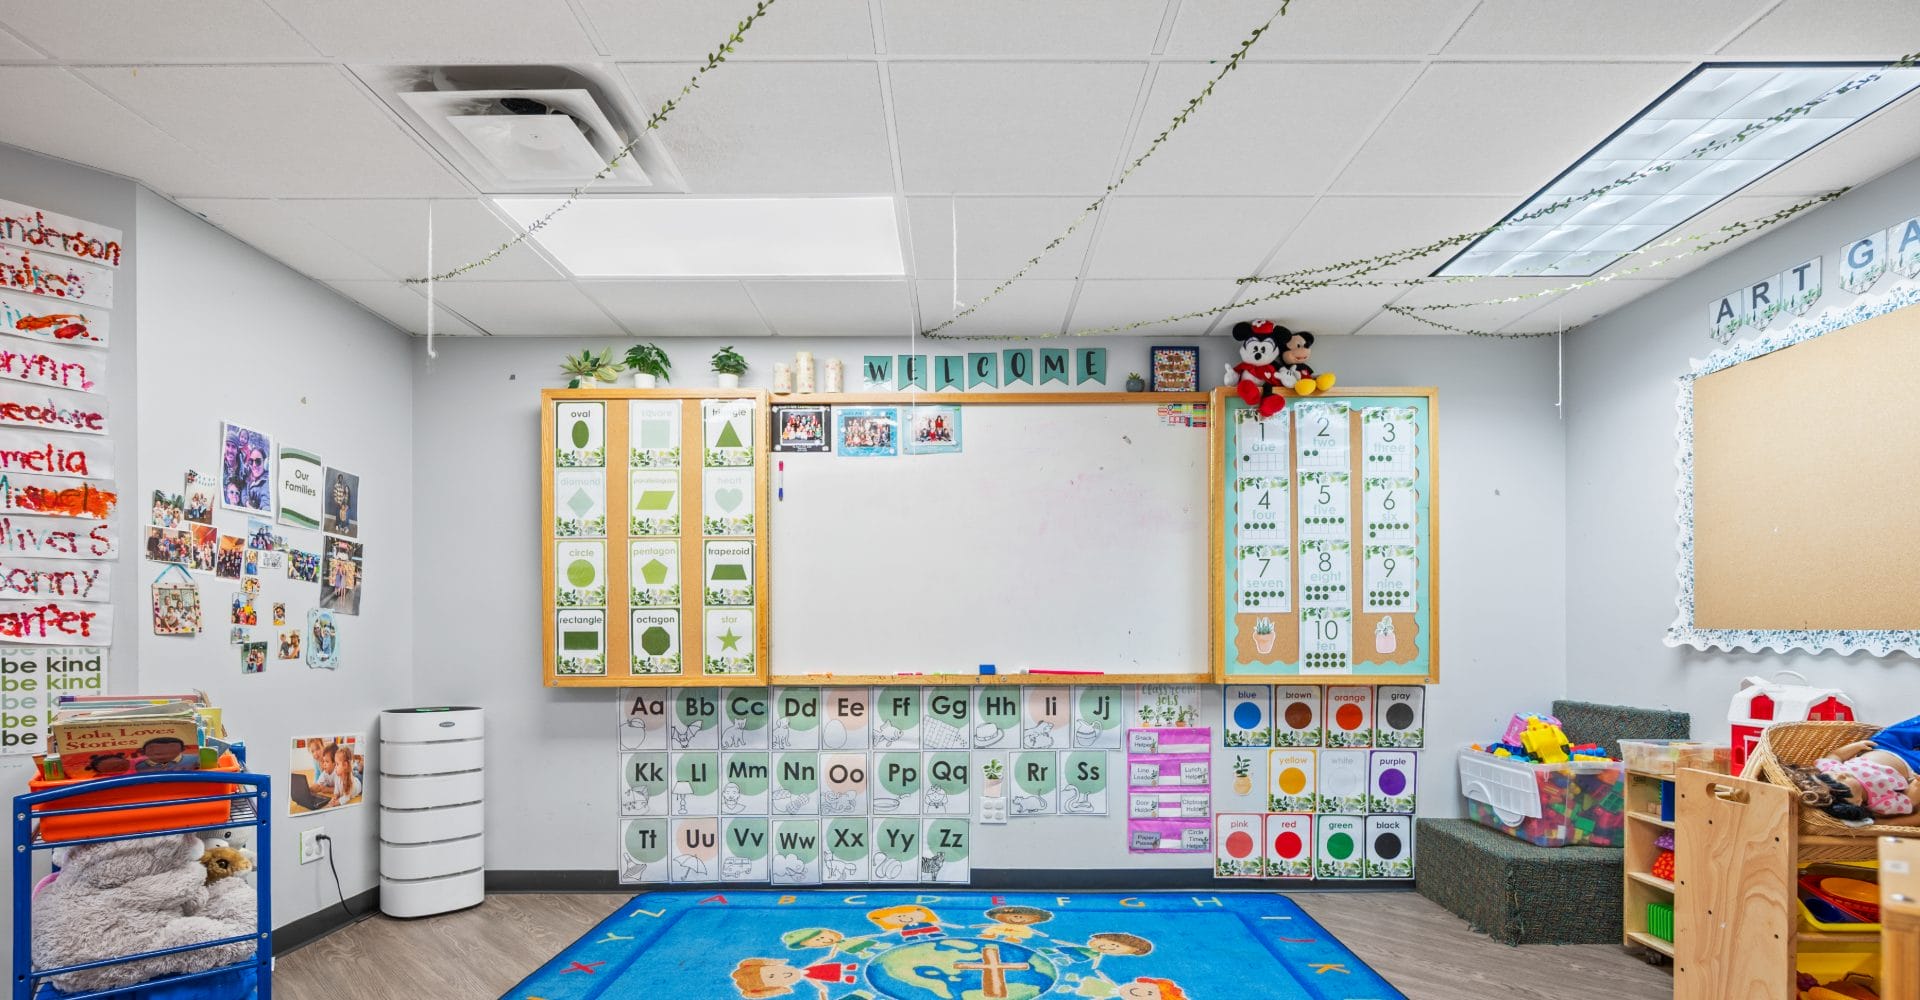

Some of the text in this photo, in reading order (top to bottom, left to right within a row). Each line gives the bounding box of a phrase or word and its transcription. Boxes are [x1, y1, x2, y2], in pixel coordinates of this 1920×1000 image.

[0, 211, 121, 267] nderson
[1716, 262, 1811, 324] ART
[868, 351, 1096, 384] WELCOME
[0, 398, 104, 431] eodore
[570, 409, 591, 419] oval
[711, 408, 747, 418] trigle
[1258, 422, 1265, 441] 1
[1316, 417, 1331, 437] 2
[1382, 422, 1396, 442] 3
[1312, 437, 1336, 447] two
[1373, 443, 1406, 453] three
[0, 443, 89, 476] melia
[294, 469, 310, 482] Our
[560, 477, 601, 487] diamond
[285, 480, 316, 498] Families
[1317, 485, 1332, 505] 5
[1257, 490, 1271, 510] 4
[1312, 503, 1337, 515] five
[1383, 490, 1396, 511] 6
[1251, 509, 1277, 520] four
[1381, 510, 1398, 521] six
[569, 548, 595, 557] circle
[633, 547, 676, 557] pentagon
[708, 547, 750, 557] trapezoid
[1258, 558, 1271, 578] 7
[1318, 552, 1332, 572] 8
[1383, 558, 1396, 578] 9
[0, 562, 99, 598] onny
[1246, 579, 1283, 588] seven
[1310, 571, 1341, 582] eight
[1376, 578, 1404, 589] nine
[559, 615, 603, 625] rectangle
[636, 615, 675, 625] octagon
[721, 615, 739, 624] star
[1315, 620, 1338, 640] 10
[1315, 641, 1337, 651] ten
[1, 655, 101, 674] be kind
[1, 672, 101, 692] be kind
[1, 693, 38, 710] be
[1237, 690, 1257, 699] blue
[1285, 690, 1312, 699] brown
[1334, 694, 1366, 703] orange
[1390, 692, 1411, 702] gray
[631, 696, 664, 716] Aa
[686, 697, 715, 716] Bb
[731, 696, 765, 716] Cc
[784, 697, 817, 717] Dd
[837, 697, 865, 717] Ee
[892, 697, 911, 716] Ff
[931, 695, 967, 718] Gg
[986, 696, 1016, 716] Hh
[1045, 696, 1057, 716] Ii
[1092, 695, 1110, 720] Jj
[1, 712, 38, 729] be
[1, 730, 38, 747] be
[65, 726, 177, 743] Lola Loves
[65, 737, 139, 751] Stories
[728, 761, 768, 779] Mm
[1278, 756, 1308, 766] yellow
[1379, 757, 1407, 768] purple
[635, 762, 665, 782] Kk
[691, 762, 707, 782] Ll
[783, 761, 816, 781] Nn
[829, 764, 865, 784] Oo
[888, 762, 917, 787] Pp
[931, 760, 968, 784] Qq
[1027, 762, 1049, 782] Rr
[1077, 761, 1100, 781] Ss
[1230, 820, 1249, 830] pink
[1281, 820, 1297, 829] red
[1328, 822, 1353, 831] green
[1376, 821, 1400, 830] black
[638, 829, 657, 849] Tt
[685, 829, 715, 848] Uu
[733, 828, 765, 847] Vv
[779, 832, 816, 850] Ww
[833, 828, 865, 848] Xx
[886, 828, 915, 853] Yy
[939, 828, 964, 848] Zz
[700, 894, 728, 904] A
[777, 895, 797, 905] B
[843, 895, 867, 905] C
[915, 895, 941, 905] D
[991, 896, 1007, 906] E
[1056, 897, 1071, 907] F
[1119, 897, 1146, 908] G
[1192, 896, 1223, 908] H
[559, 961, 606, 975] X
[1307, 963, 1351, 975] K
